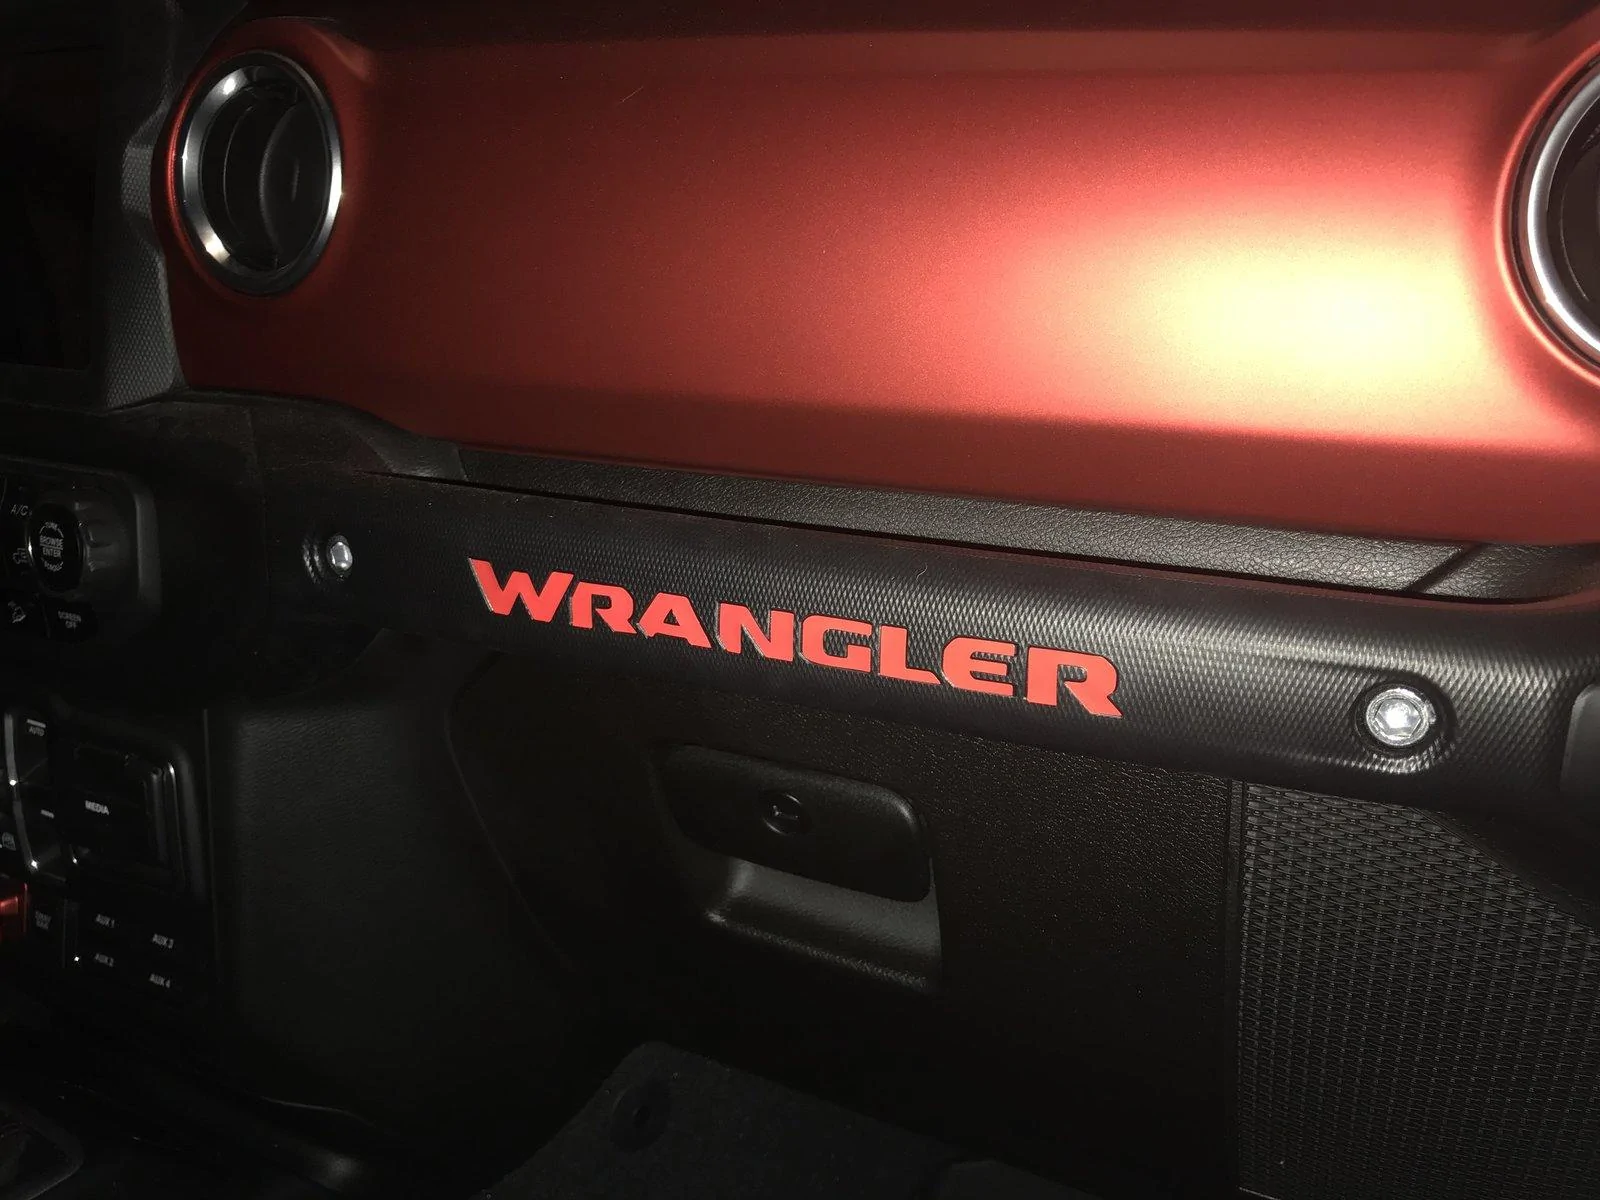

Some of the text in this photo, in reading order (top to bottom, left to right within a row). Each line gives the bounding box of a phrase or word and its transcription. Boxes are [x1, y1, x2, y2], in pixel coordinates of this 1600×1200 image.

[467, 556, 1124, 719] WRANGLER
[84, 800, 110, 816] MEDIA
[95, 913, 110, 927] AUX
[152, 933, 168, 947] AUX
[148, 973, 165, 987] AUX
